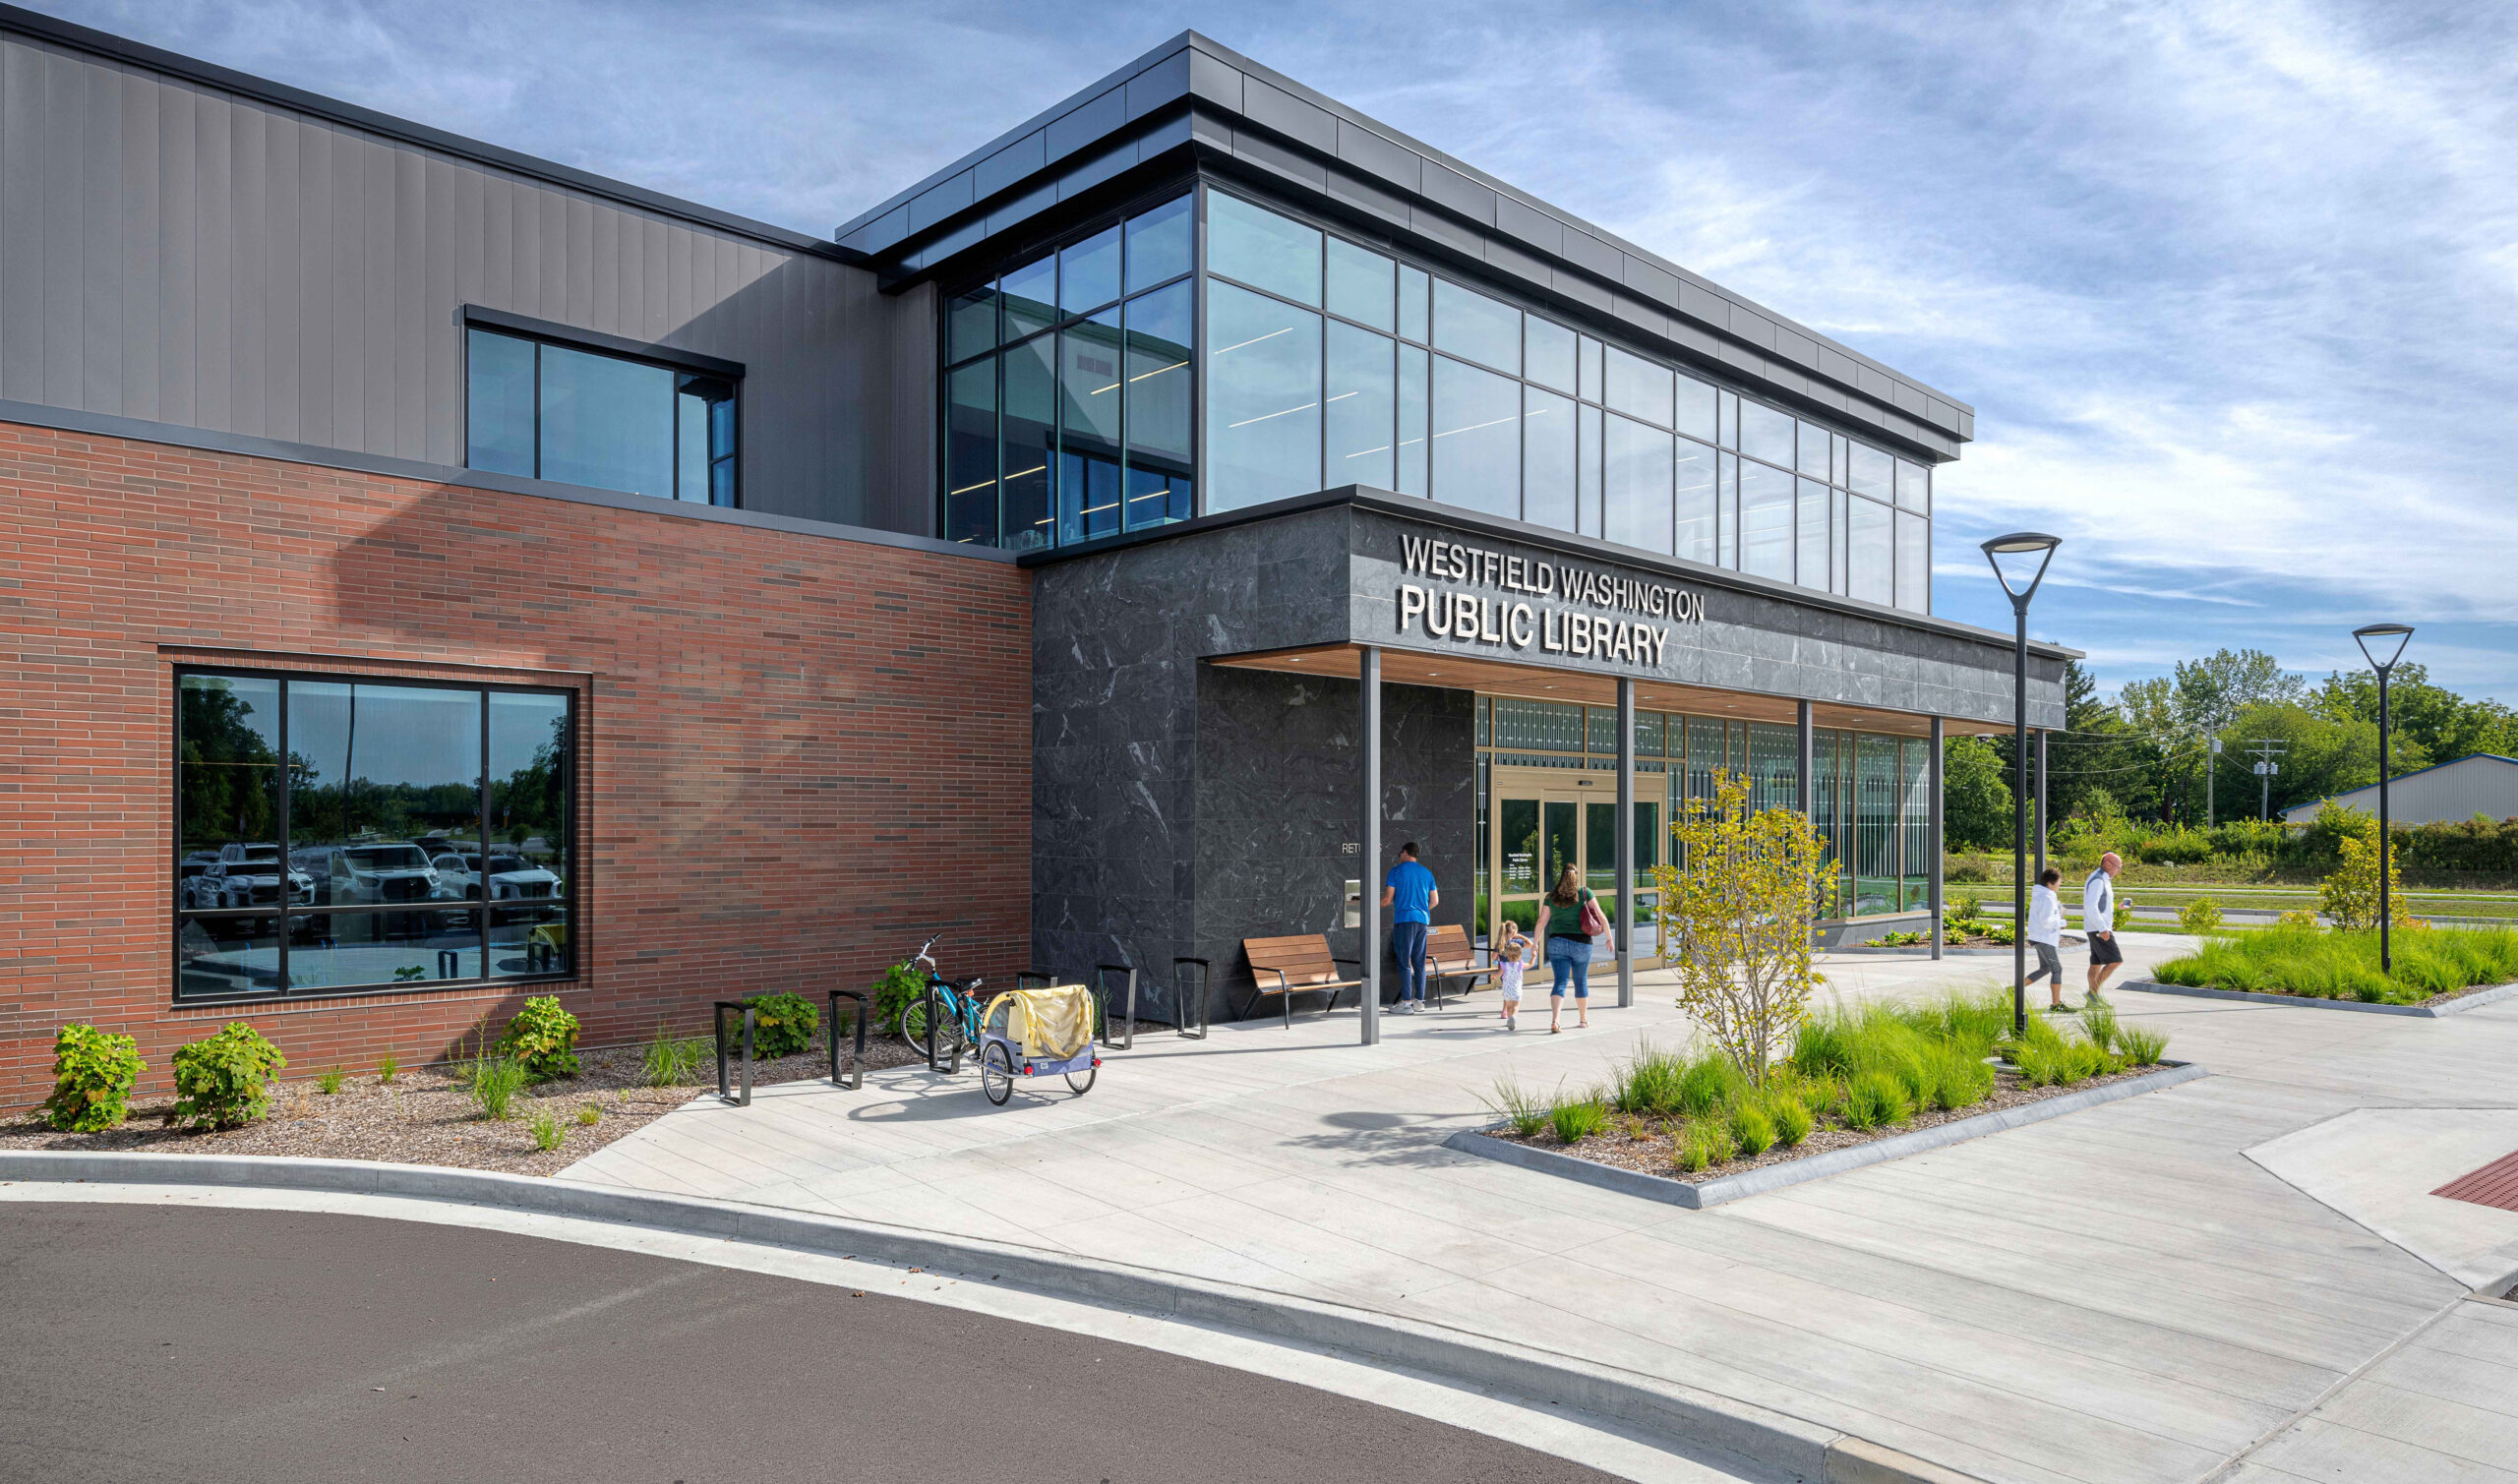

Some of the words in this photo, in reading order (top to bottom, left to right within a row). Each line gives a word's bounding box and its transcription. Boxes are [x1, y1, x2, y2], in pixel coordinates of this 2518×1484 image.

[1402, 533, 1554, 595] WESTFIELD
[1560, 565, 1705, 623] WASHINGTON
[1402, 583, 1533, 647] PUBLIC
[1544, 608, 1669, 665] LIBRARY
